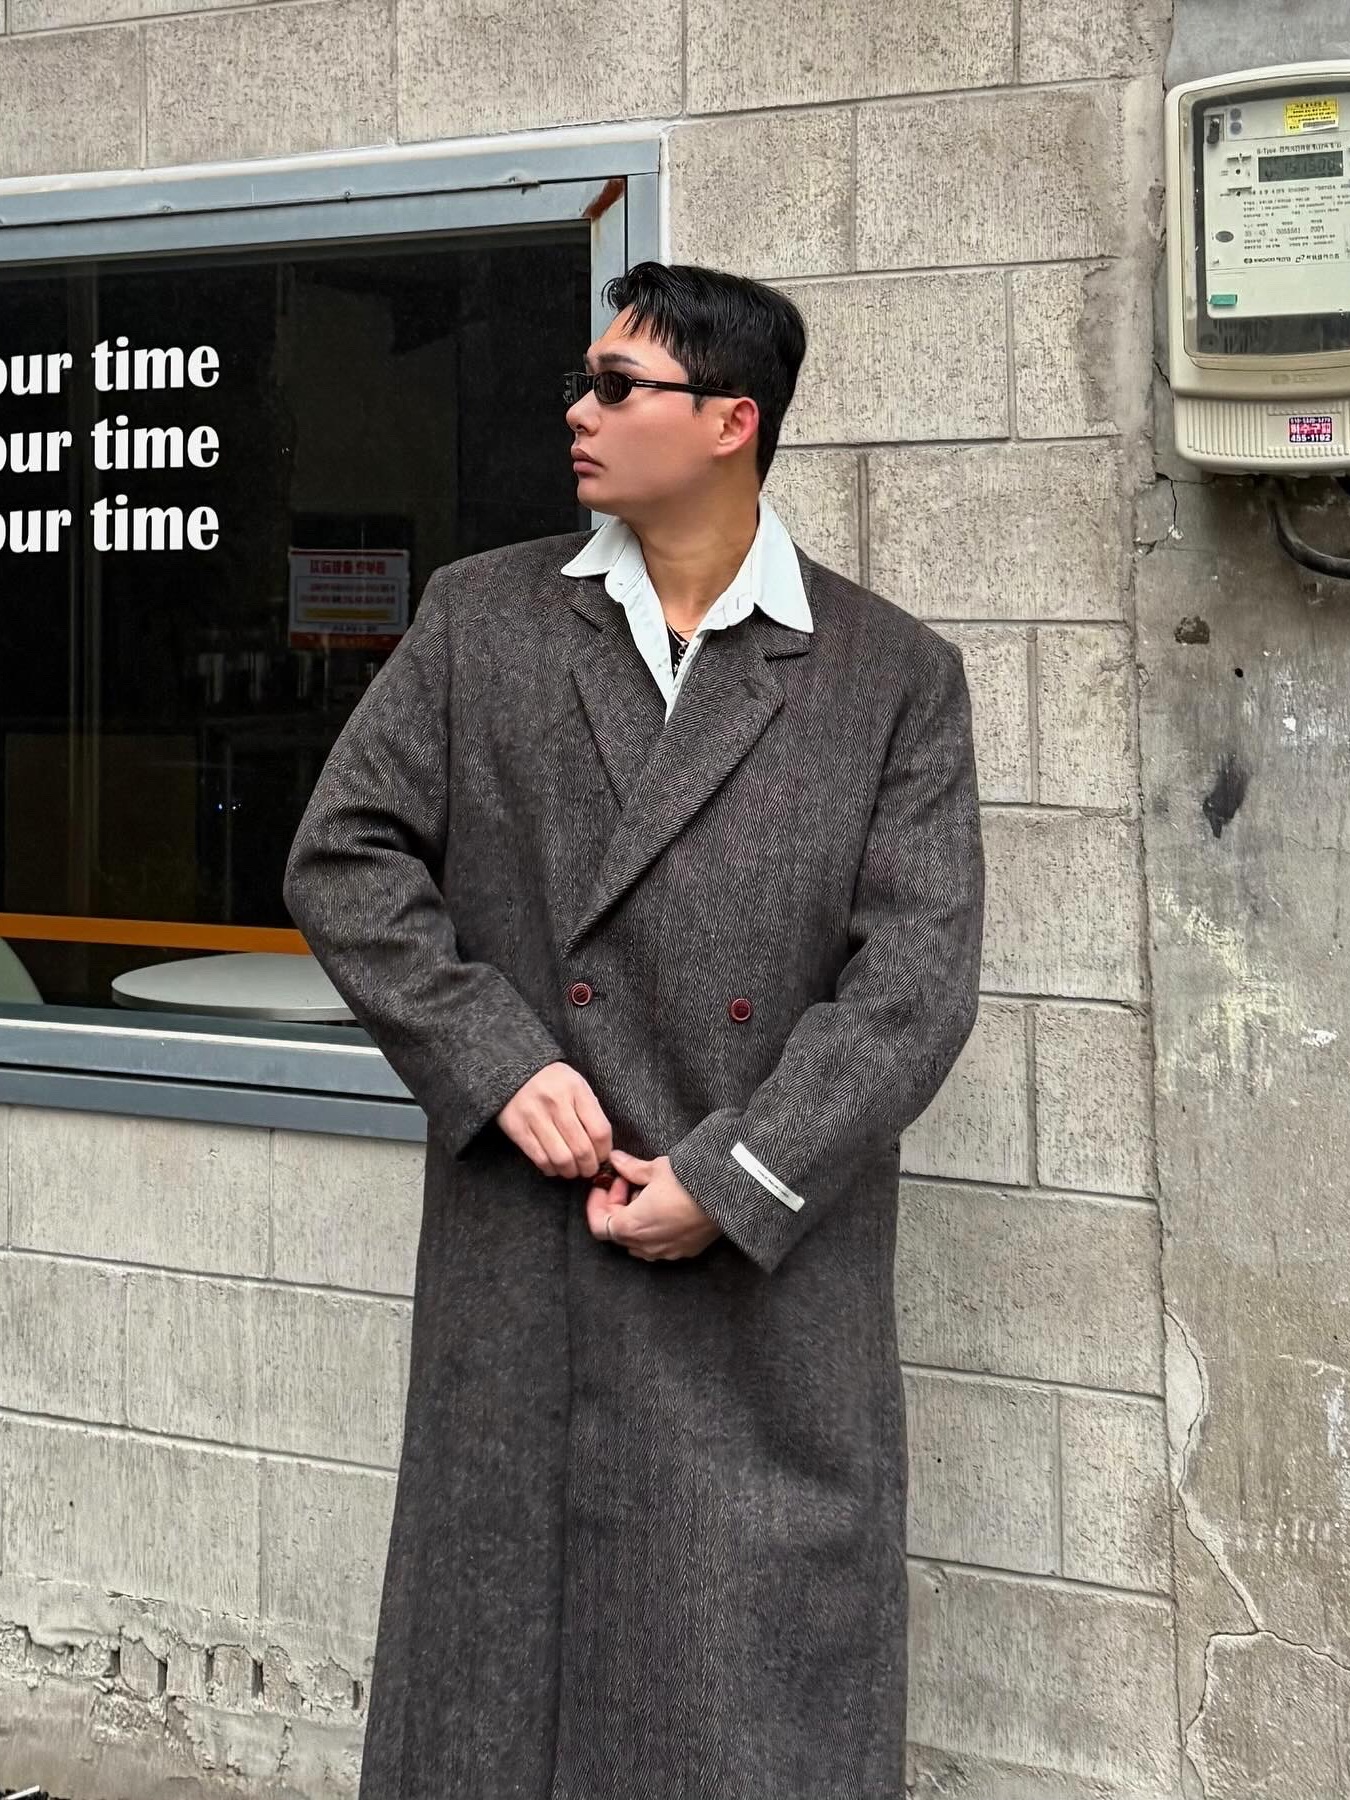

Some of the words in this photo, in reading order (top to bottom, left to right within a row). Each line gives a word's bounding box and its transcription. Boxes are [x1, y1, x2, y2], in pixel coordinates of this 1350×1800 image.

[0, 353, 72, 395] ur
[91, 336, 219, 391] time
[0, 431, 72, 473] ur
[91, 415, 219, 470] time
[0, 510, 71, 553] ur
[90, 494, 219, 551] time
